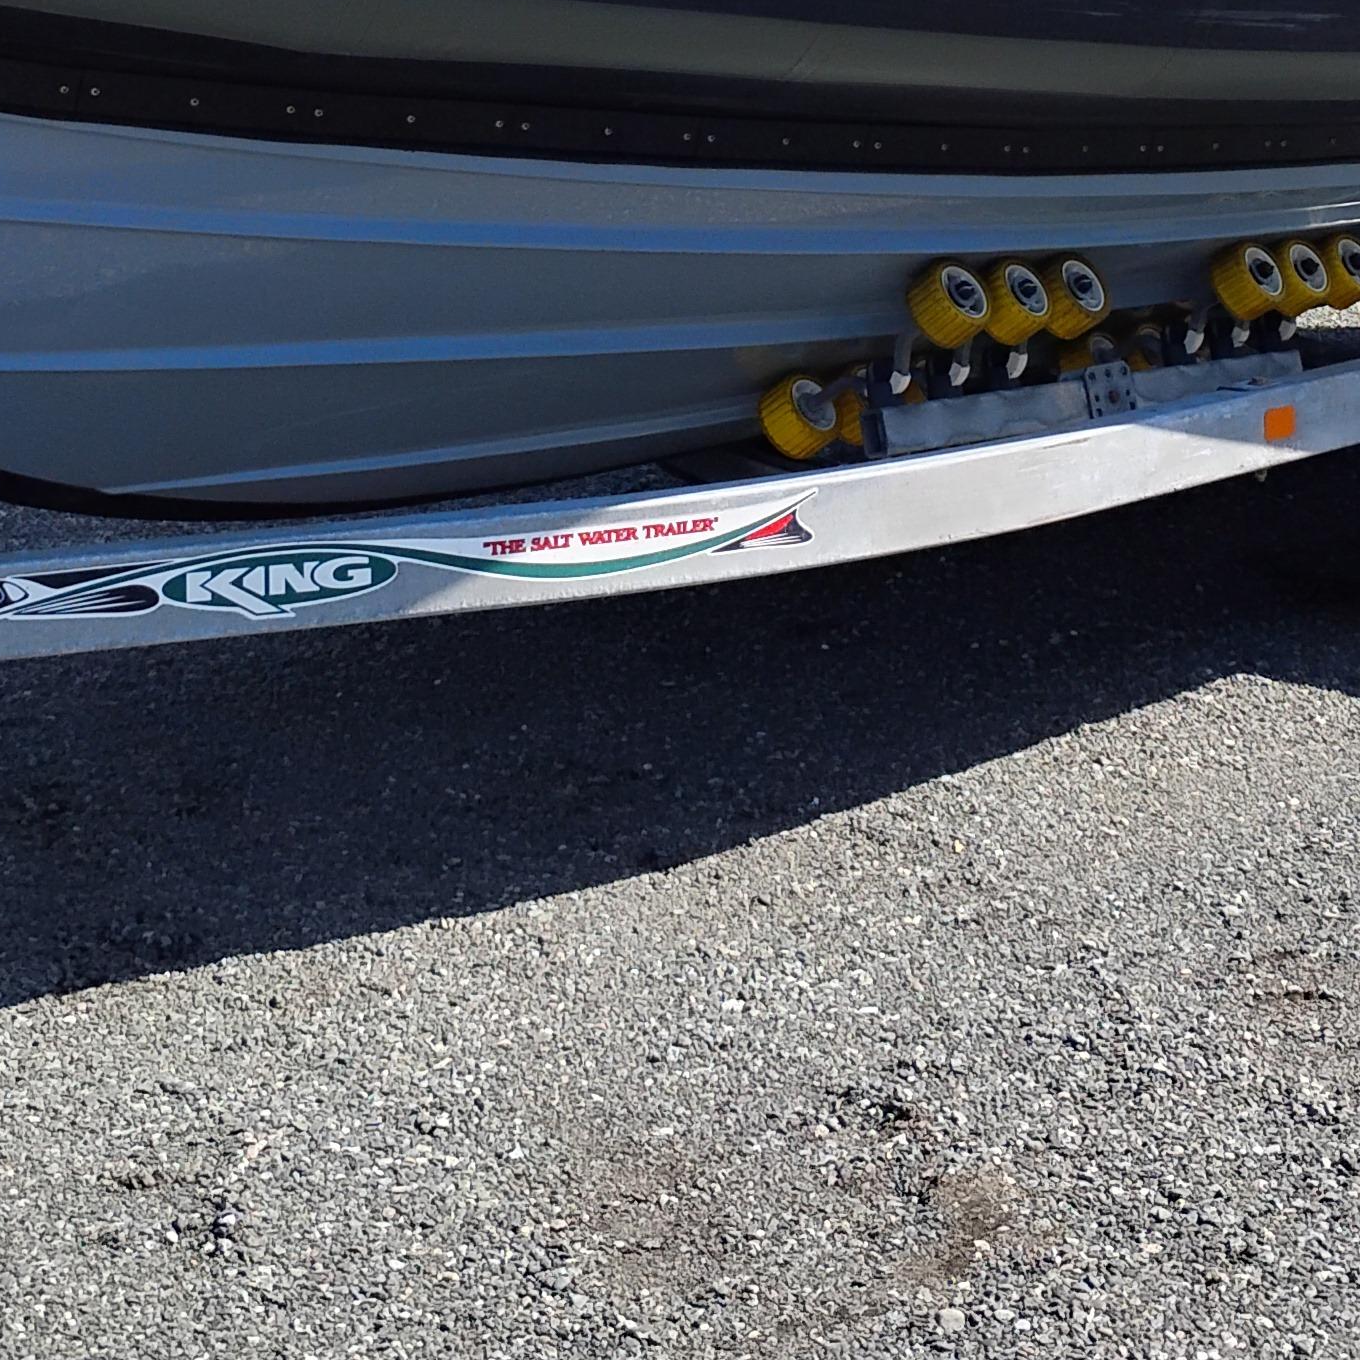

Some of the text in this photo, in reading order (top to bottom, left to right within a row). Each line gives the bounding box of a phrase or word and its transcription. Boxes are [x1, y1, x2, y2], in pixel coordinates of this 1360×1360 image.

[530, 533, 574, 552] SALT
[578, 527, 639, 547] WATER
[186, 555, 373, 615] KING
